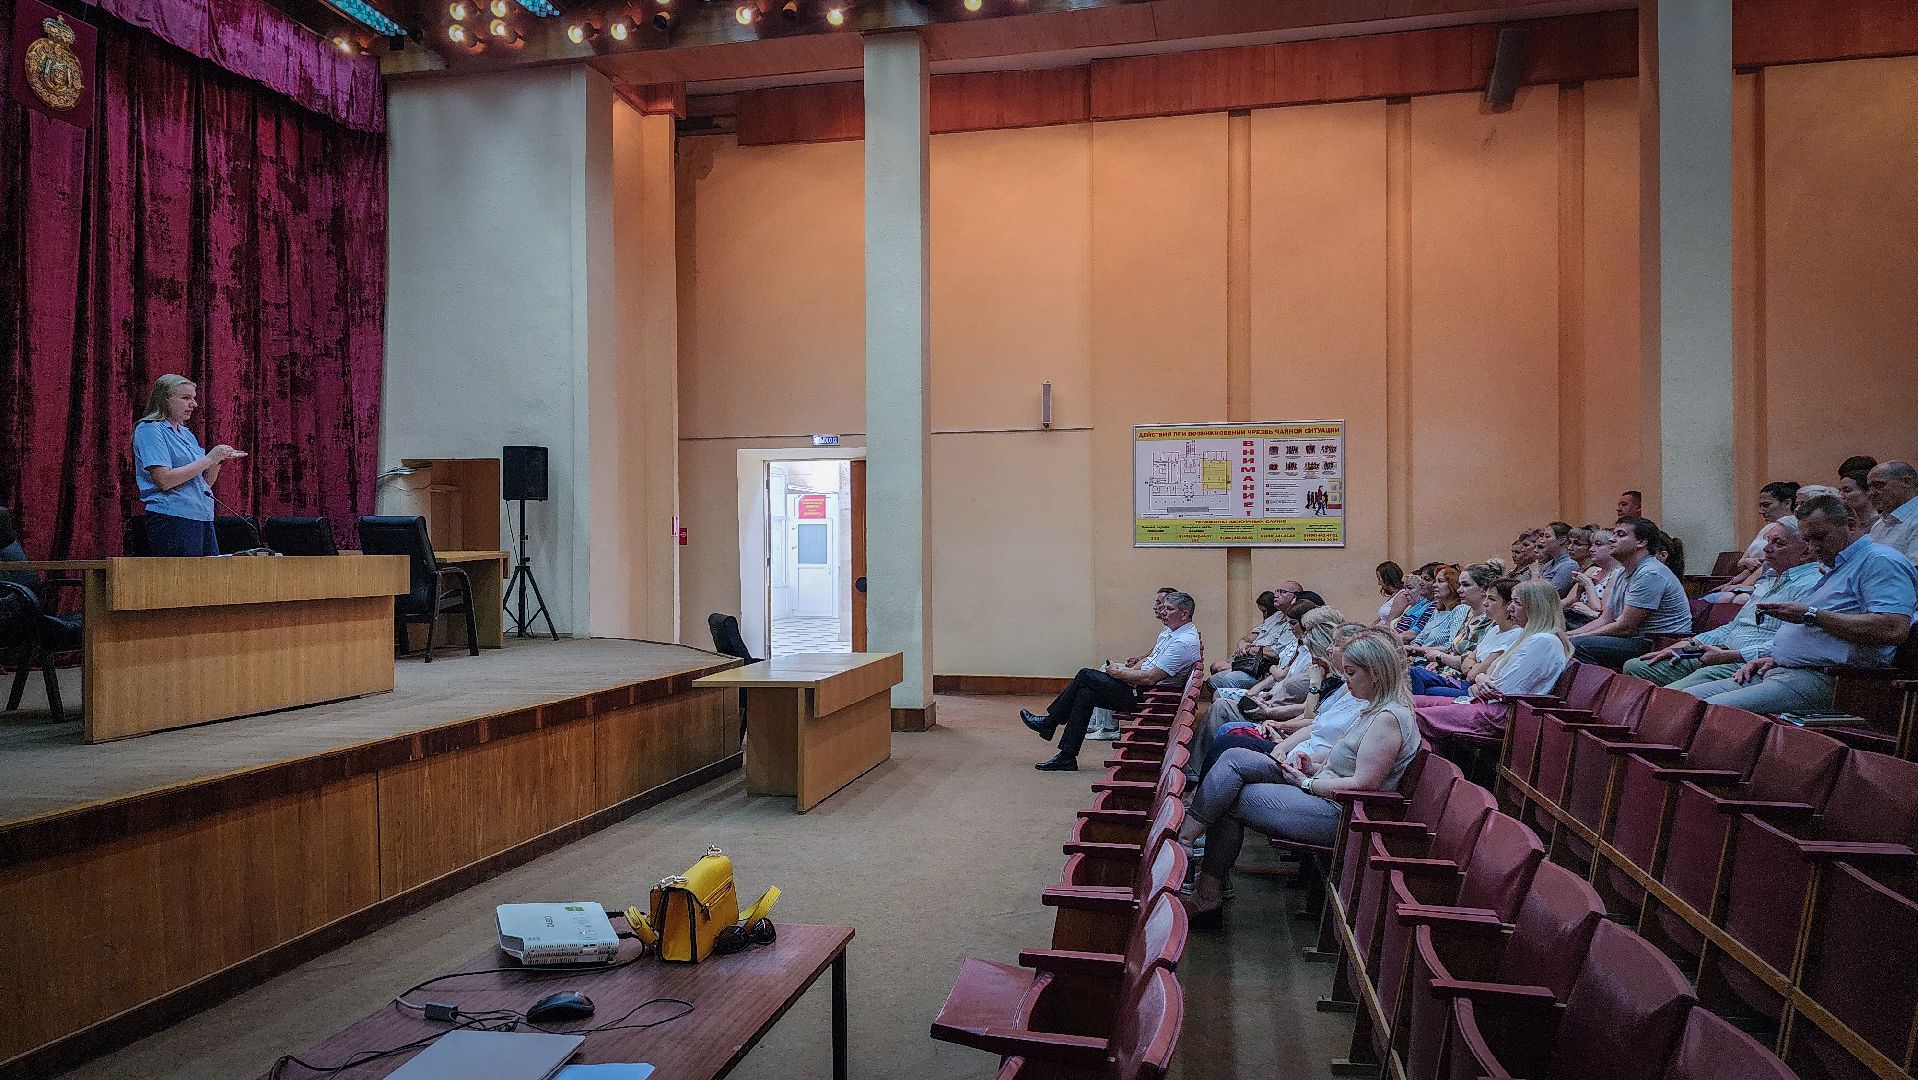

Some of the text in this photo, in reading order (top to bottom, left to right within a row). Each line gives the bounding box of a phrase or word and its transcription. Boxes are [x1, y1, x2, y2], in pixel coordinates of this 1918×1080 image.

[1138, 431, 1172, 439] ДЕЙСТВИЯ
[1188, 429, 1246, 437] ВОЗНИКНОВЕНИИ
[1240, 440, 1256, 517] ВНИМАНИЕ!
